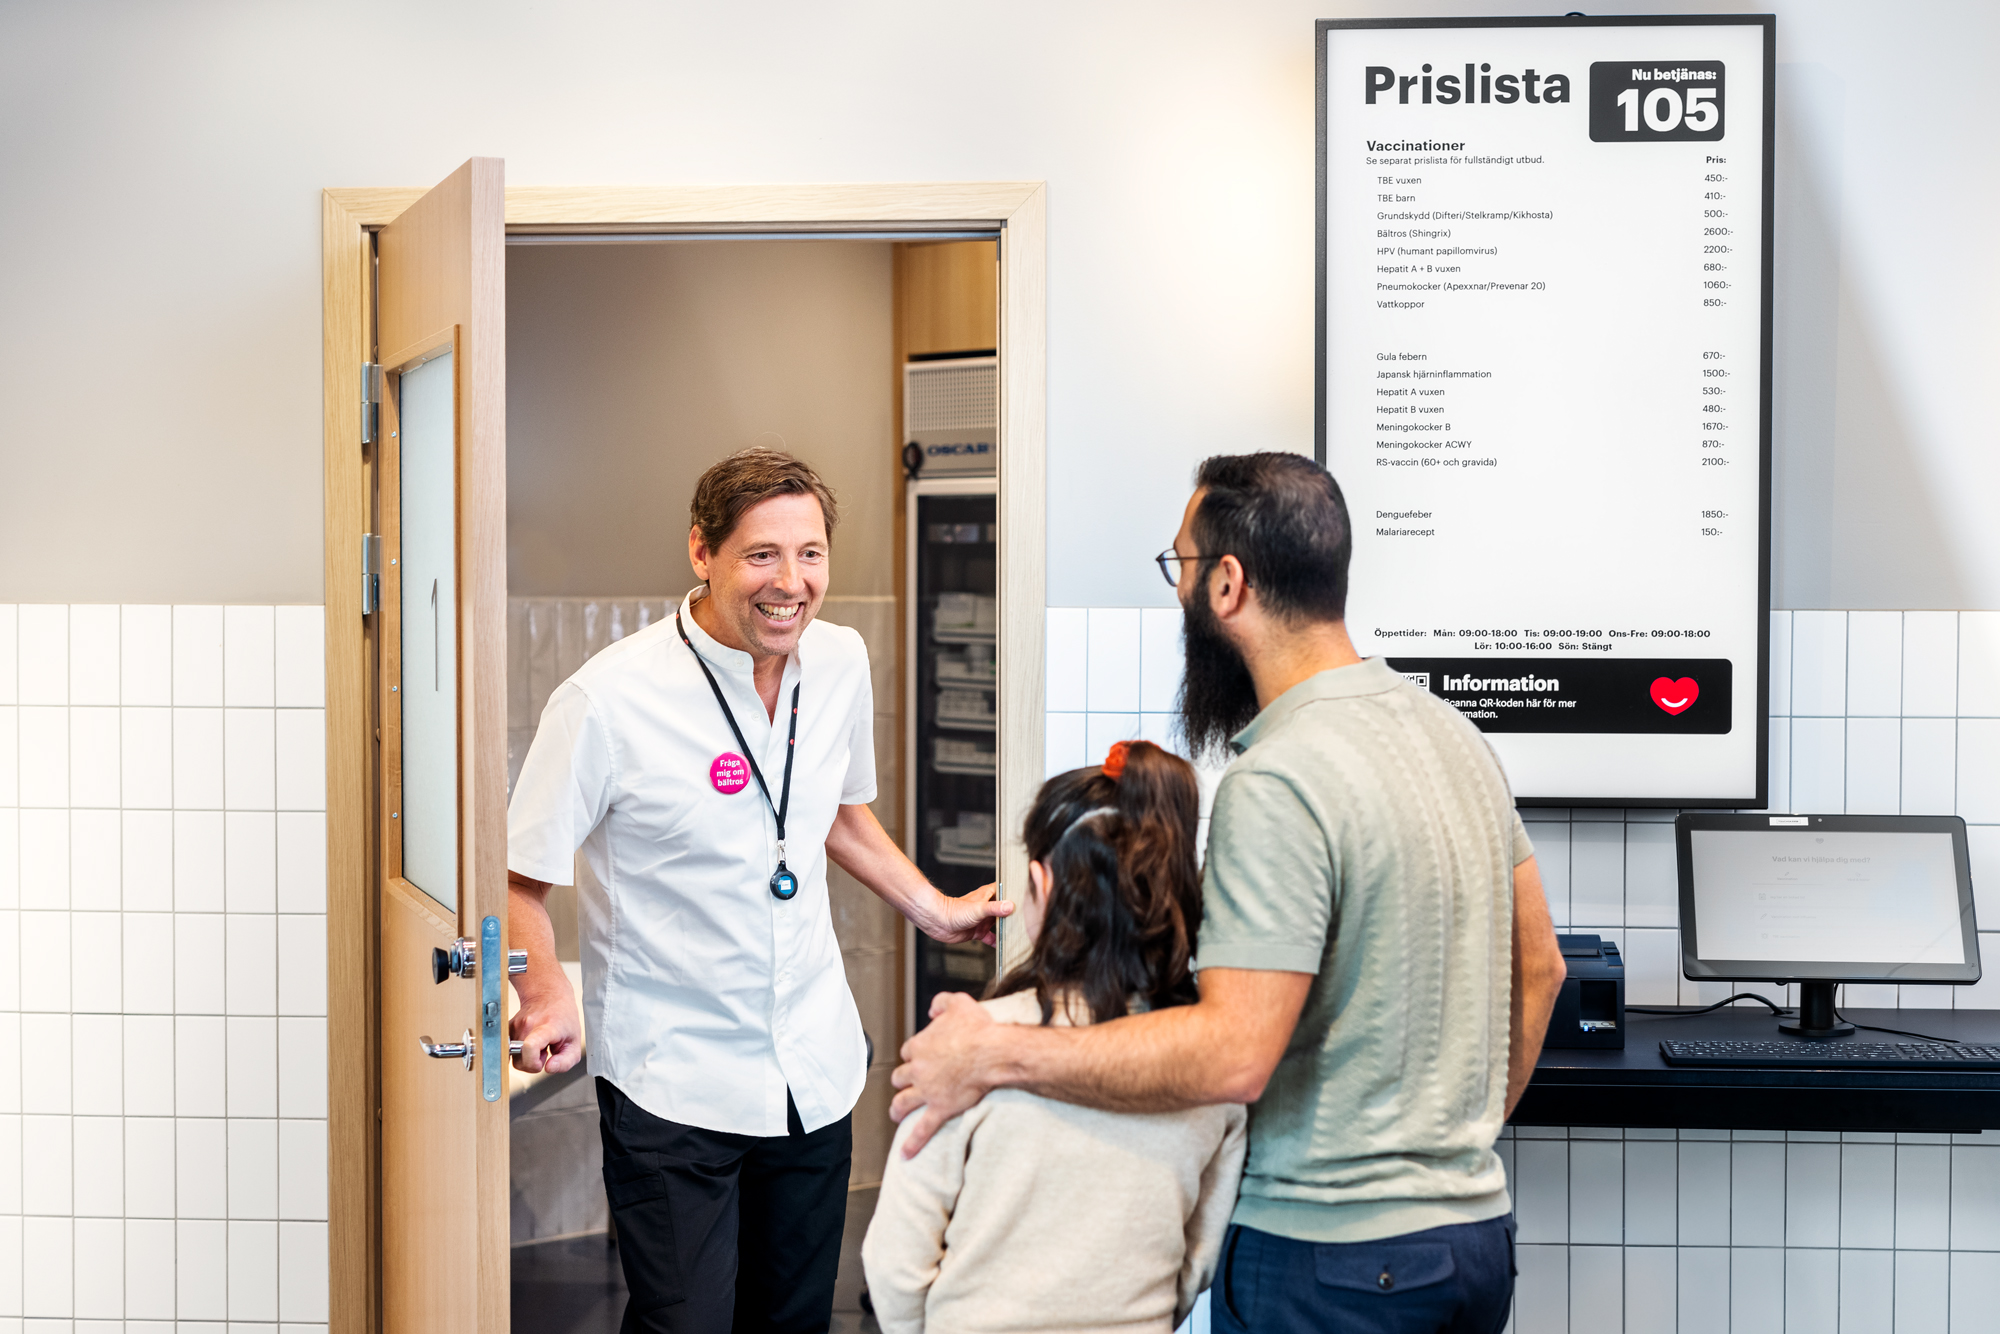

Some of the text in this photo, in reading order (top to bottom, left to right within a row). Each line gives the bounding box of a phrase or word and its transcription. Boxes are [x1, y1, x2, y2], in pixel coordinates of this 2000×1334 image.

[1632, 68, 1717, 83] Nu betjänas:
[1365, 62, 1570, 105] Prislista
[1617, 88, 1718, 132] 105
[1366, 139, 1465, 152] Vaccinationer
[1366, 155, 1544, 166] Se separat prislista för fullständigt utbud.
[1706, 155, 1726, 164] Pris:
[1377, 176, 1393, 185] TBE
[1704, 174, 1728, 182] 450:-
[1377, 194, 1416, 202] TBE barn
[1704, 192, 1726, 200] 410:-
[1377, 210, 1553, 221] Grundskydd (Difteri/Stelkramp/Kikhosta)
[1704, 209, 1728, 218] 500:-
[1377, 229, 1451, 239] Bältros (Shingrix)
[1704, 227, 1733, 236] 2600:-
[1377, 246, 1498, 256] HPV (humant papillomvirus)
[1704, 245, 1733, 254] 2200:-
[1377, 265, 1409, 274] Hepatit
[1411, 265, 1417, 273] A
[1427, 264, 1433, 273] B
[1703, 263, 1727, 271] 680:-
[1377, 281, 1546, 292] Pneumokocker (Apexxnar/Prevenar 20)
[1703, 281, 1732, 289] 1060:-
[1376, 300, 1425, 310] Vattkoppor
[1703, 298, 1727, 307] 850:-
[1376, 352, 1427, 361] Gula febern
[1703, 351, 1725, 360] 670:-
[1376, 370, 1492, 380] Japansk hjärninflammation
[1703, 369, 1730, 377] 1500:-
[1376, 388, 1408, 397] Hepatit
[1410, 388, 1417, 396] A
[1702, 387, 1726, 395] 530:-
[1376, 406, 1408, 415] Hepatit
[1410, 405, 1416, 414] B
[1702, 404, 1726, 413] 480:-
[1376, 423, 1451, 433] Meningokocker B
[1702, 422, 1728, 430] 1670:-
[1376, 440, 1472, 450] Meningokocker ACWY
[1702, 440, 1725, 448] 870:-
[1376, 458, 1497, 468] RS-vaccin (60+ och gravida)
[1702, 457, 1729, 466] 2100:-
[1376, 510, 1432, 520] Denguefeber
[1701, 510, 1728, 518] 1850:-
[1376, 528, 1435, 537] Malariarecept
[1701, 528, 1723, 536] 150:-
[1374, 628, 1711, 638] Öppettider: Mån: 09:00-18:00 Tis: 09:00-19:00 Ons-Fre: 09:00-18:00
[1474, 642, 1612, 652] Lör: 10:00-16:00 Sön: Stängt
[1443, 674, 1559, 691] Information
[1479, 698, 1524, 708] QR-koden
[1526, 698, 1541, 708] här
[1543, 698, 1556, 708] för
[1558, 700, 1577, 708] mer
[1460, 710, 1499, 719] rmation.
[720, 759, 741, 768] Fråga
[716, 769, 731, 778] mig
[717, 778, 744, 787] bältros
[1811, 856, 1835, 864] hjälpa
[1836, 856, 1848, 865] dig
